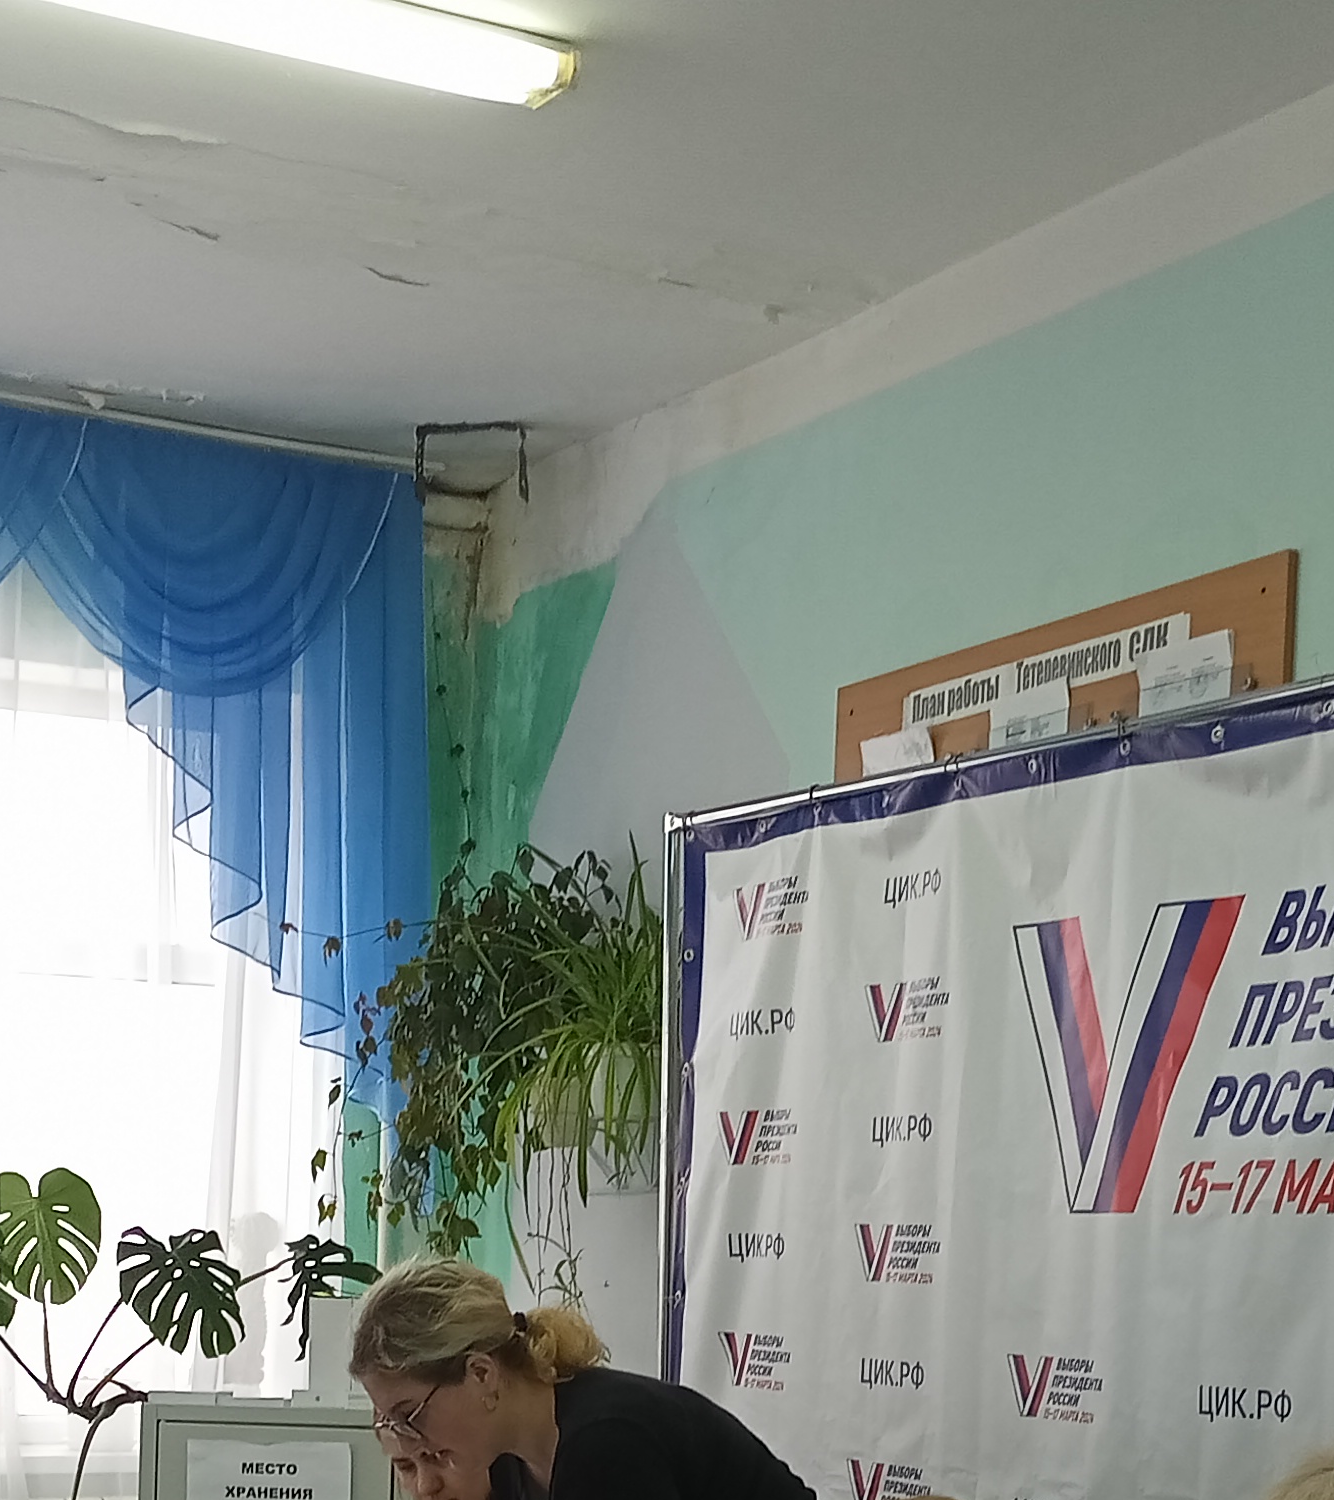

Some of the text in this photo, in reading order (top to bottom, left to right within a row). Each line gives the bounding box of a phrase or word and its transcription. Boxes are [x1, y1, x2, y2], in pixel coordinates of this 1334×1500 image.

[912, 693, 945, 724] План
[947, 675, 1000, 716] работы
[884, 868, 941, 908] ЦИК.РФ
[730, 1006, 795, 1041] ЦИК.РФ
[860, 1357, 924, 1390] ЦИК.РФ
[1199, 1384, 1291, 1422] ЦИК.РФ
[242, 1462, 297, 1476] МЕСТО
[225, 1485, 313, 1500] ХРАНЕНИЯ
